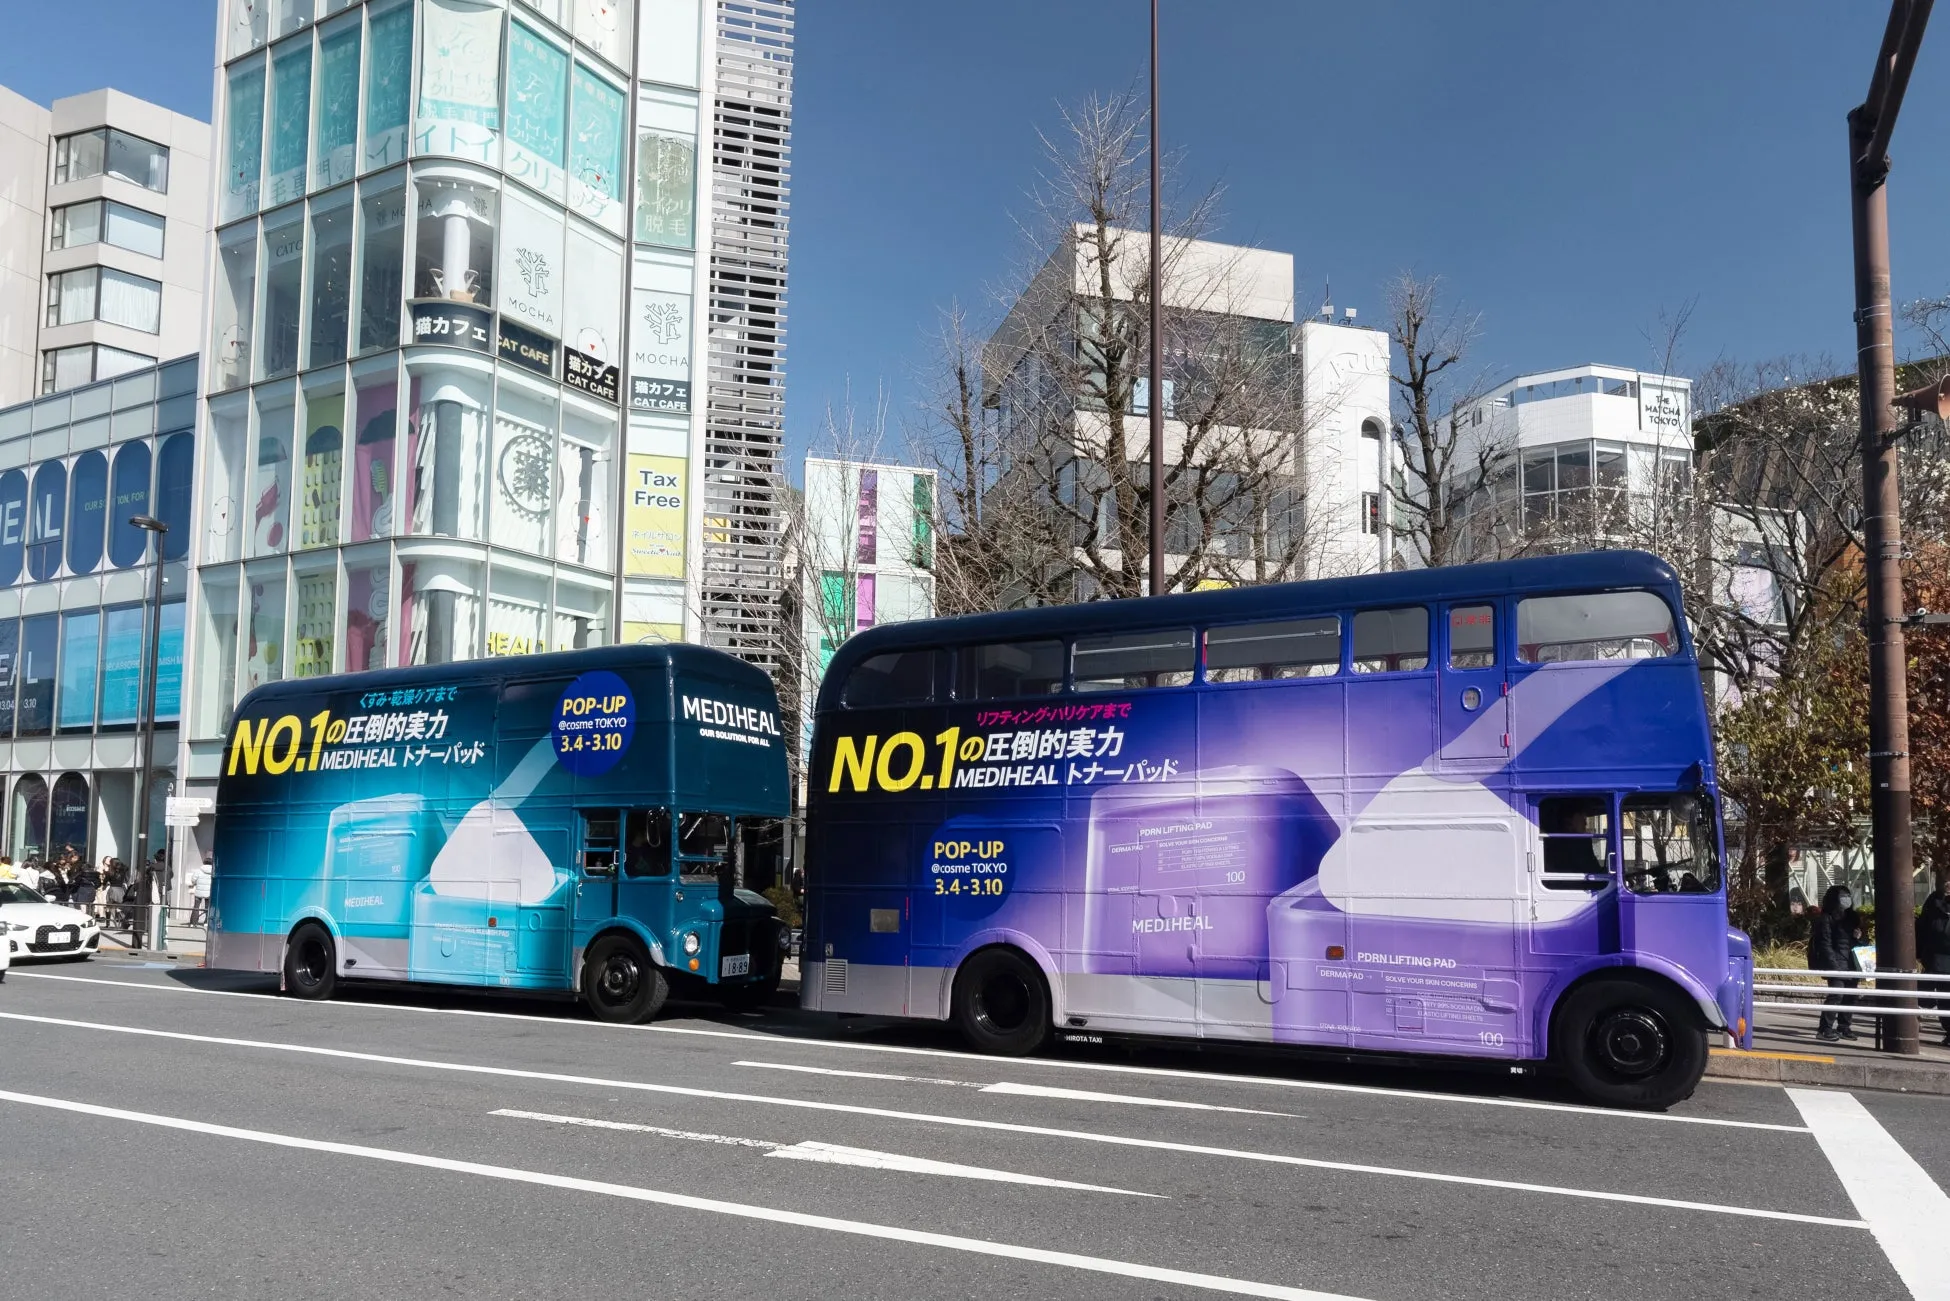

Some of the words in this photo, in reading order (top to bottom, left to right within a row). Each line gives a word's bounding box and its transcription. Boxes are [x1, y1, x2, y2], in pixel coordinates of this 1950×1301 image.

[391, 198, 432, 221] MOHA
[645, 214, 687, 236] 脱毛
[508, 297, 553, 325] MOCHA
[415, 316, 486, 342] 猫カフェ
[498, 335, 518, 352] CAT
[520, 344, 550, 365] CAFE
[635, 352, 689, 368] MOCHA
[569, 354, 615, 386] 猫カフェ
[567, 372, 588, 389] CAT
[590, 381, 615, 399] CAFE
[635, 380, 687, 397] 猫カフェ
[634, 397, 658, 408] CAT
[659, 399, 687, 411] CAFE
[1656, 395, 1670, 404] THE
[1645, 404, 1680, 416] MATCHA
[1649, 416, 1678, 426] TOKYO
[639, 470, 677, 488] Tax
[635, 490, 681, 508] Free
[360, 686, 457, 708] くすみ・乾燥ケアまで
[562, 696, 627, 716] POP-UP
[682, 695, 781, 736] MEDIHEAL
[977, 702, 1132, 727] リフティング・ハリケアまで
[558, 718, 593, 731] @cosme
[595, 717, 627, 729] TOKYO
[700, 728, 715, 738] OUR
[716, 730, 747, 744] SOLUTION,
[748, 735, 760, 745] FOR
[320, 748, 397, 771] MEDIHEAL
[403, 741, 485, 768] トナーパッド
[955, 764, 1058, 788] MEDIHEAL
[1067, 759, 1179, 785] トナーパッド
[1140, 827, 1162, 837] PDRN
[1162, 824, 1194, 835] LIFTING
[1195, 821, 1213, 831] PAD
[934, 841, 1004, 859] POP-UP
[931, 863, 970, 874] @cosme
[971, 863, 1007, 874] TOKYO
[1225, 871, 1246, 883] 100
[345, 895, 384, 908] MEDIHEAL
[1132, 915, 1213, 934] MEDIHEAL
[1357, 951, 1388, 964] PDRN
[1389, 954, 1431, 967] LIFTING
[1433, 958, 1457, 969] PAD
[1320, 969, 1347, 978] DERMA
[1348, 972, 1364, 980] PAD
[1385, 975, 1406, 984] SOLVE
[1407, 976, 1424, 985] YOUR
[1425, 978, 1440, 987] SKIN
[1440, 980, 1478, 989] CONCERNS
[1477, 1031, 1504, 1047] 100
